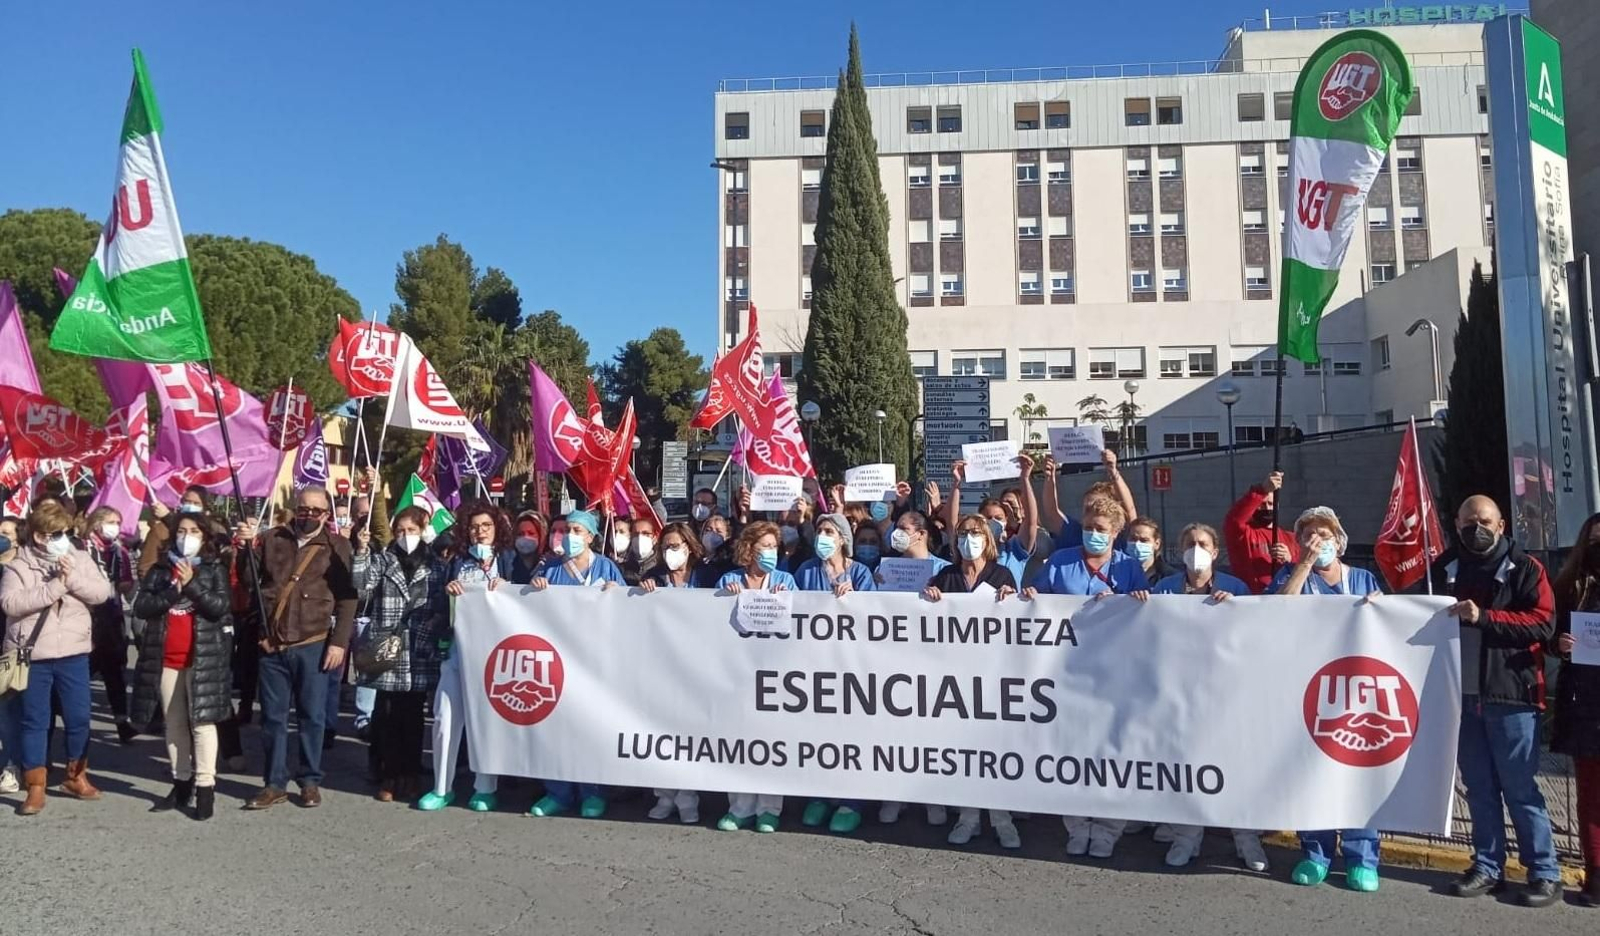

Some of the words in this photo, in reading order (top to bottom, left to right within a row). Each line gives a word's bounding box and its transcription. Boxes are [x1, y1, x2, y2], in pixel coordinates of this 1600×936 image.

[1331, 62, 1376, 89] UGT
[1542, 160, 1565, 352] Universitario
[926, 421, 963, 429] mortuorio
[1555, 366, 1573, 493] Hospital
[738, 613, 857, 642] TOR
[867, 614, 909, 643] DE
[920, 615, 1079, 647] LIMPIEZA
[494, 649, 556, 686] UGT
[755, 669, 1058, 724] ESENCIALES
[1317, 675, 1401, 720] UGT
[617, 732, 789, 767] LUCHAMOS
[798, 741, 862, 771] POR
[873, 745, 1025, 781] NUESTRO
[1034, 754, 1225, 795] CONVENIO
